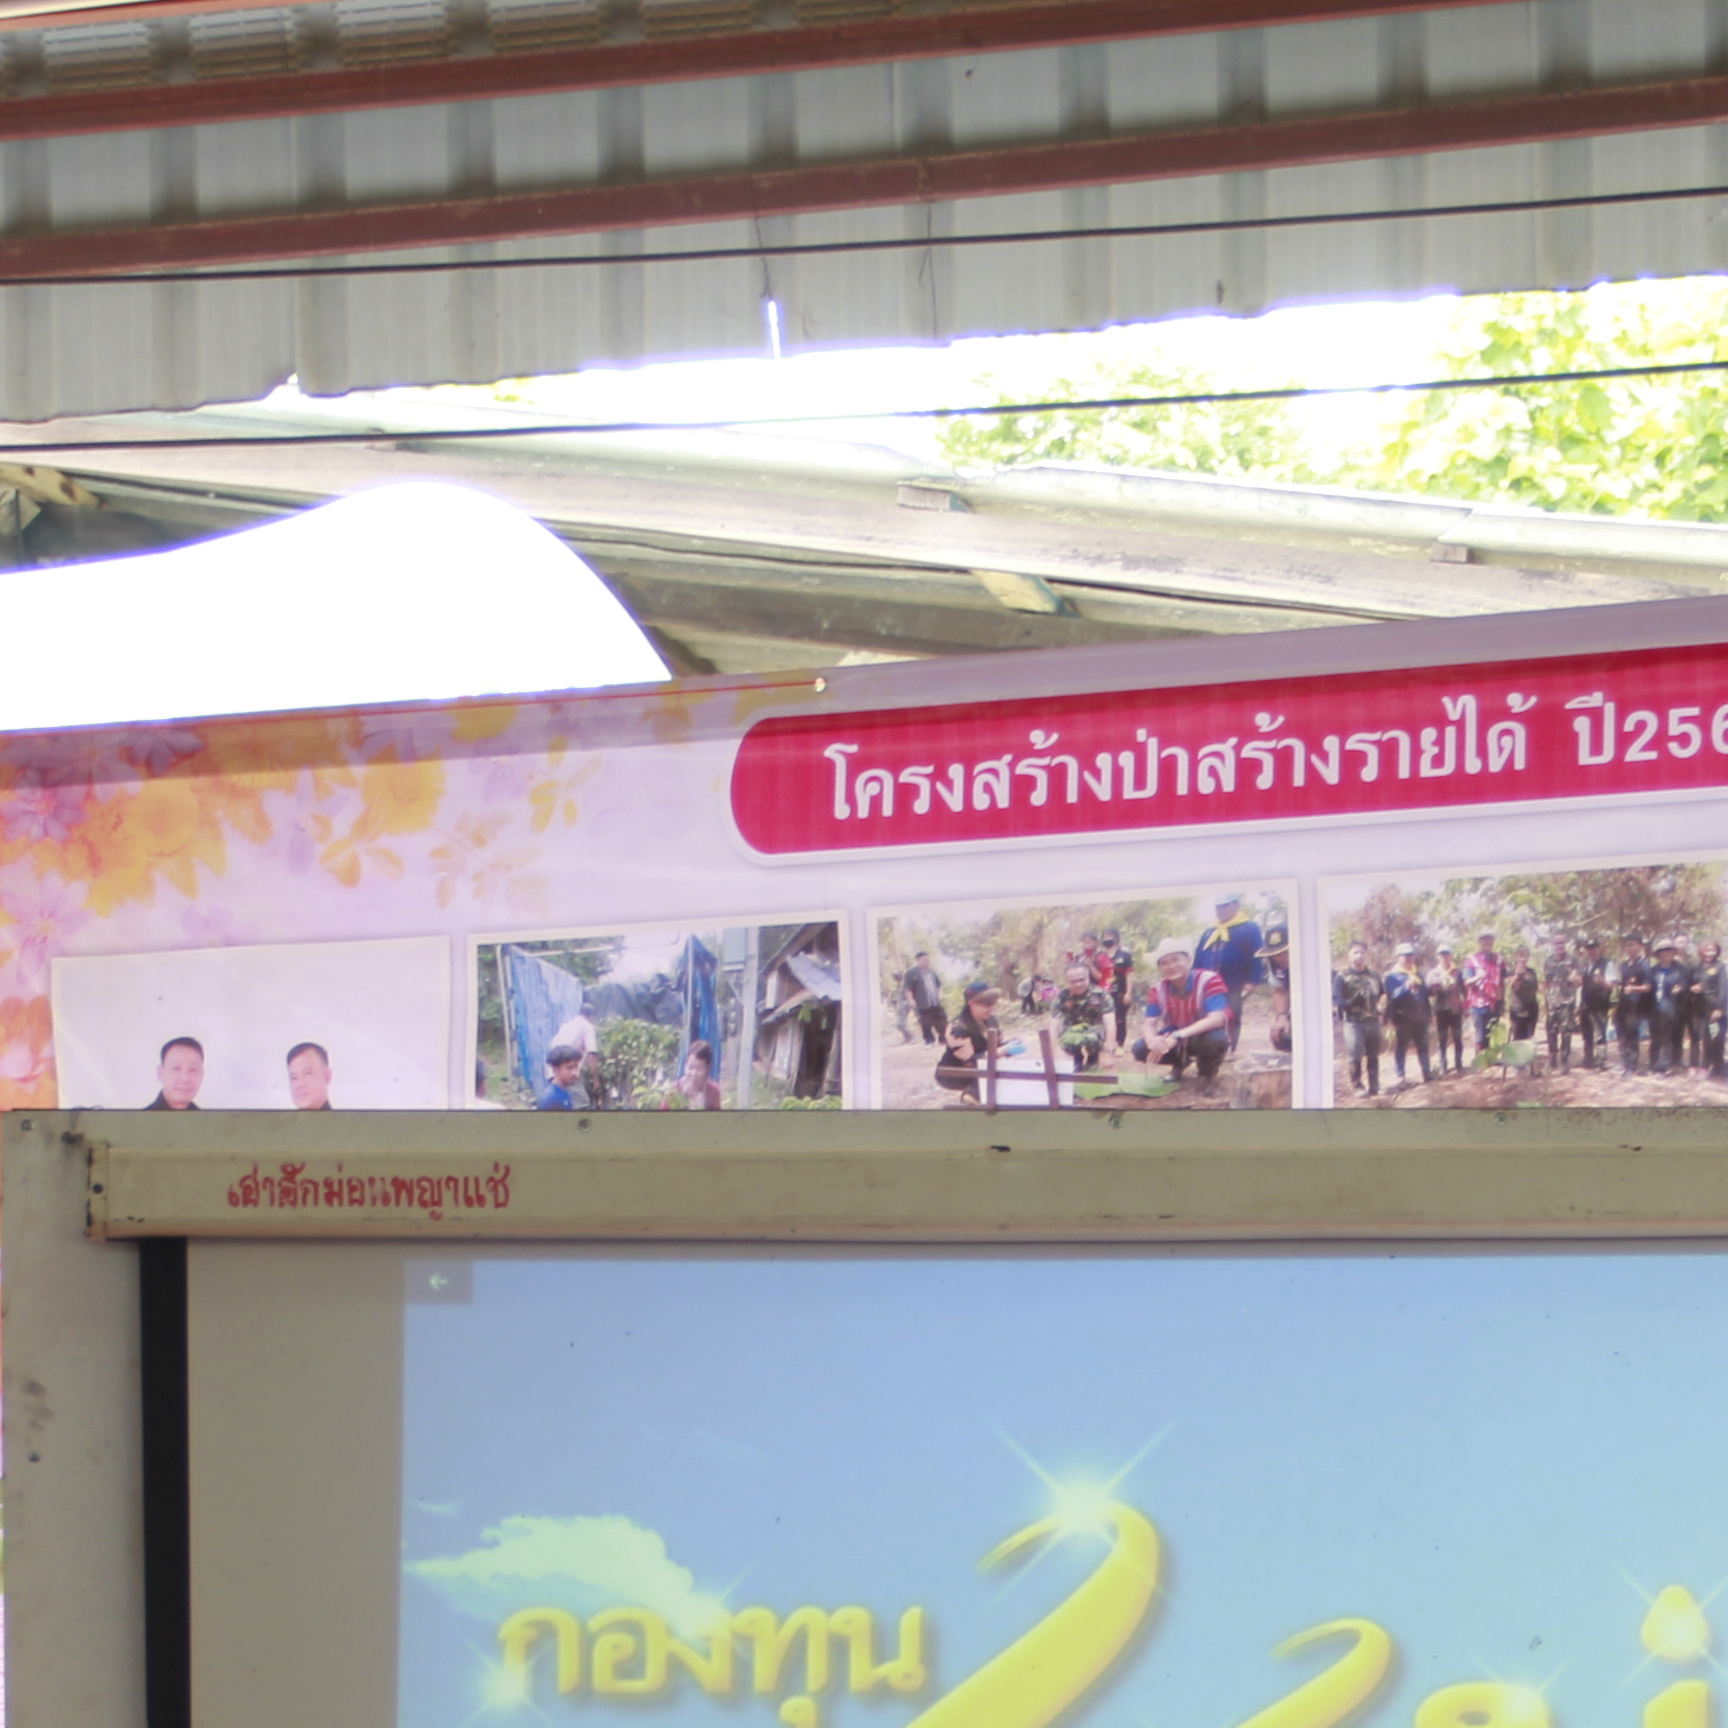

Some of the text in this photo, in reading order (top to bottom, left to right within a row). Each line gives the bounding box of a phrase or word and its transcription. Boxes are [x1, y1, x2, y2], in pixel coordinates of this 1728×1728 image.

[824, 692, 1537, 821] โครงสร้างป่าสร้างรายได้
